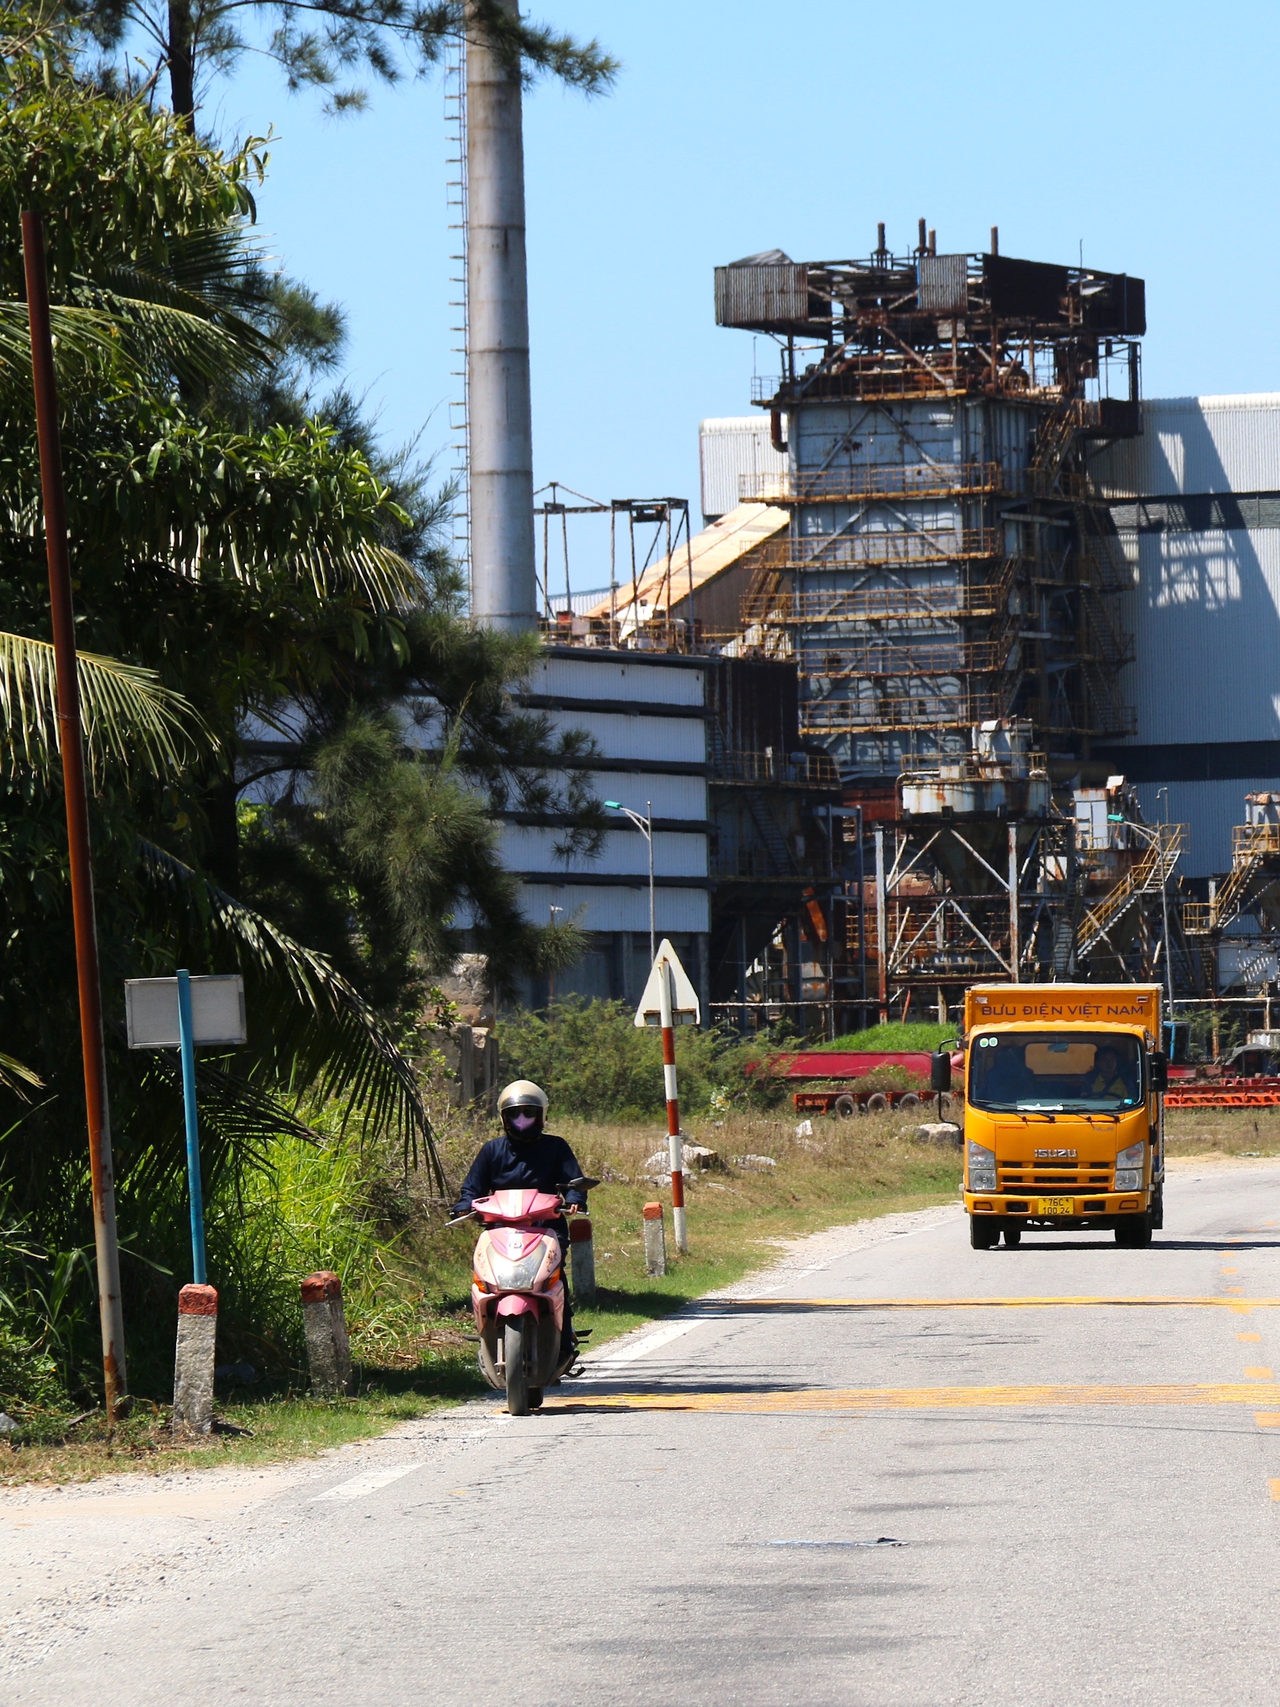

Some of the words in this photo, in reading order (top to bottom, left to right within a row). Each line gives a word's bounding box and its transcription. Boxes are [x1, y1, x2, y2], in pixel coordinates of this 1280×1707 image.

[981, 1004, 1016, 1016] BƯU
[1022, 1002, 1063, 1018] ĐIỆN
[1067, 1002, 1102, 1018] VIỆT
[1107, 1005, 1144, 1015] NAM
[1034, 1149, 1077, 1158] ISUZU
[1048, 1198, 1064, 1207] 76C
